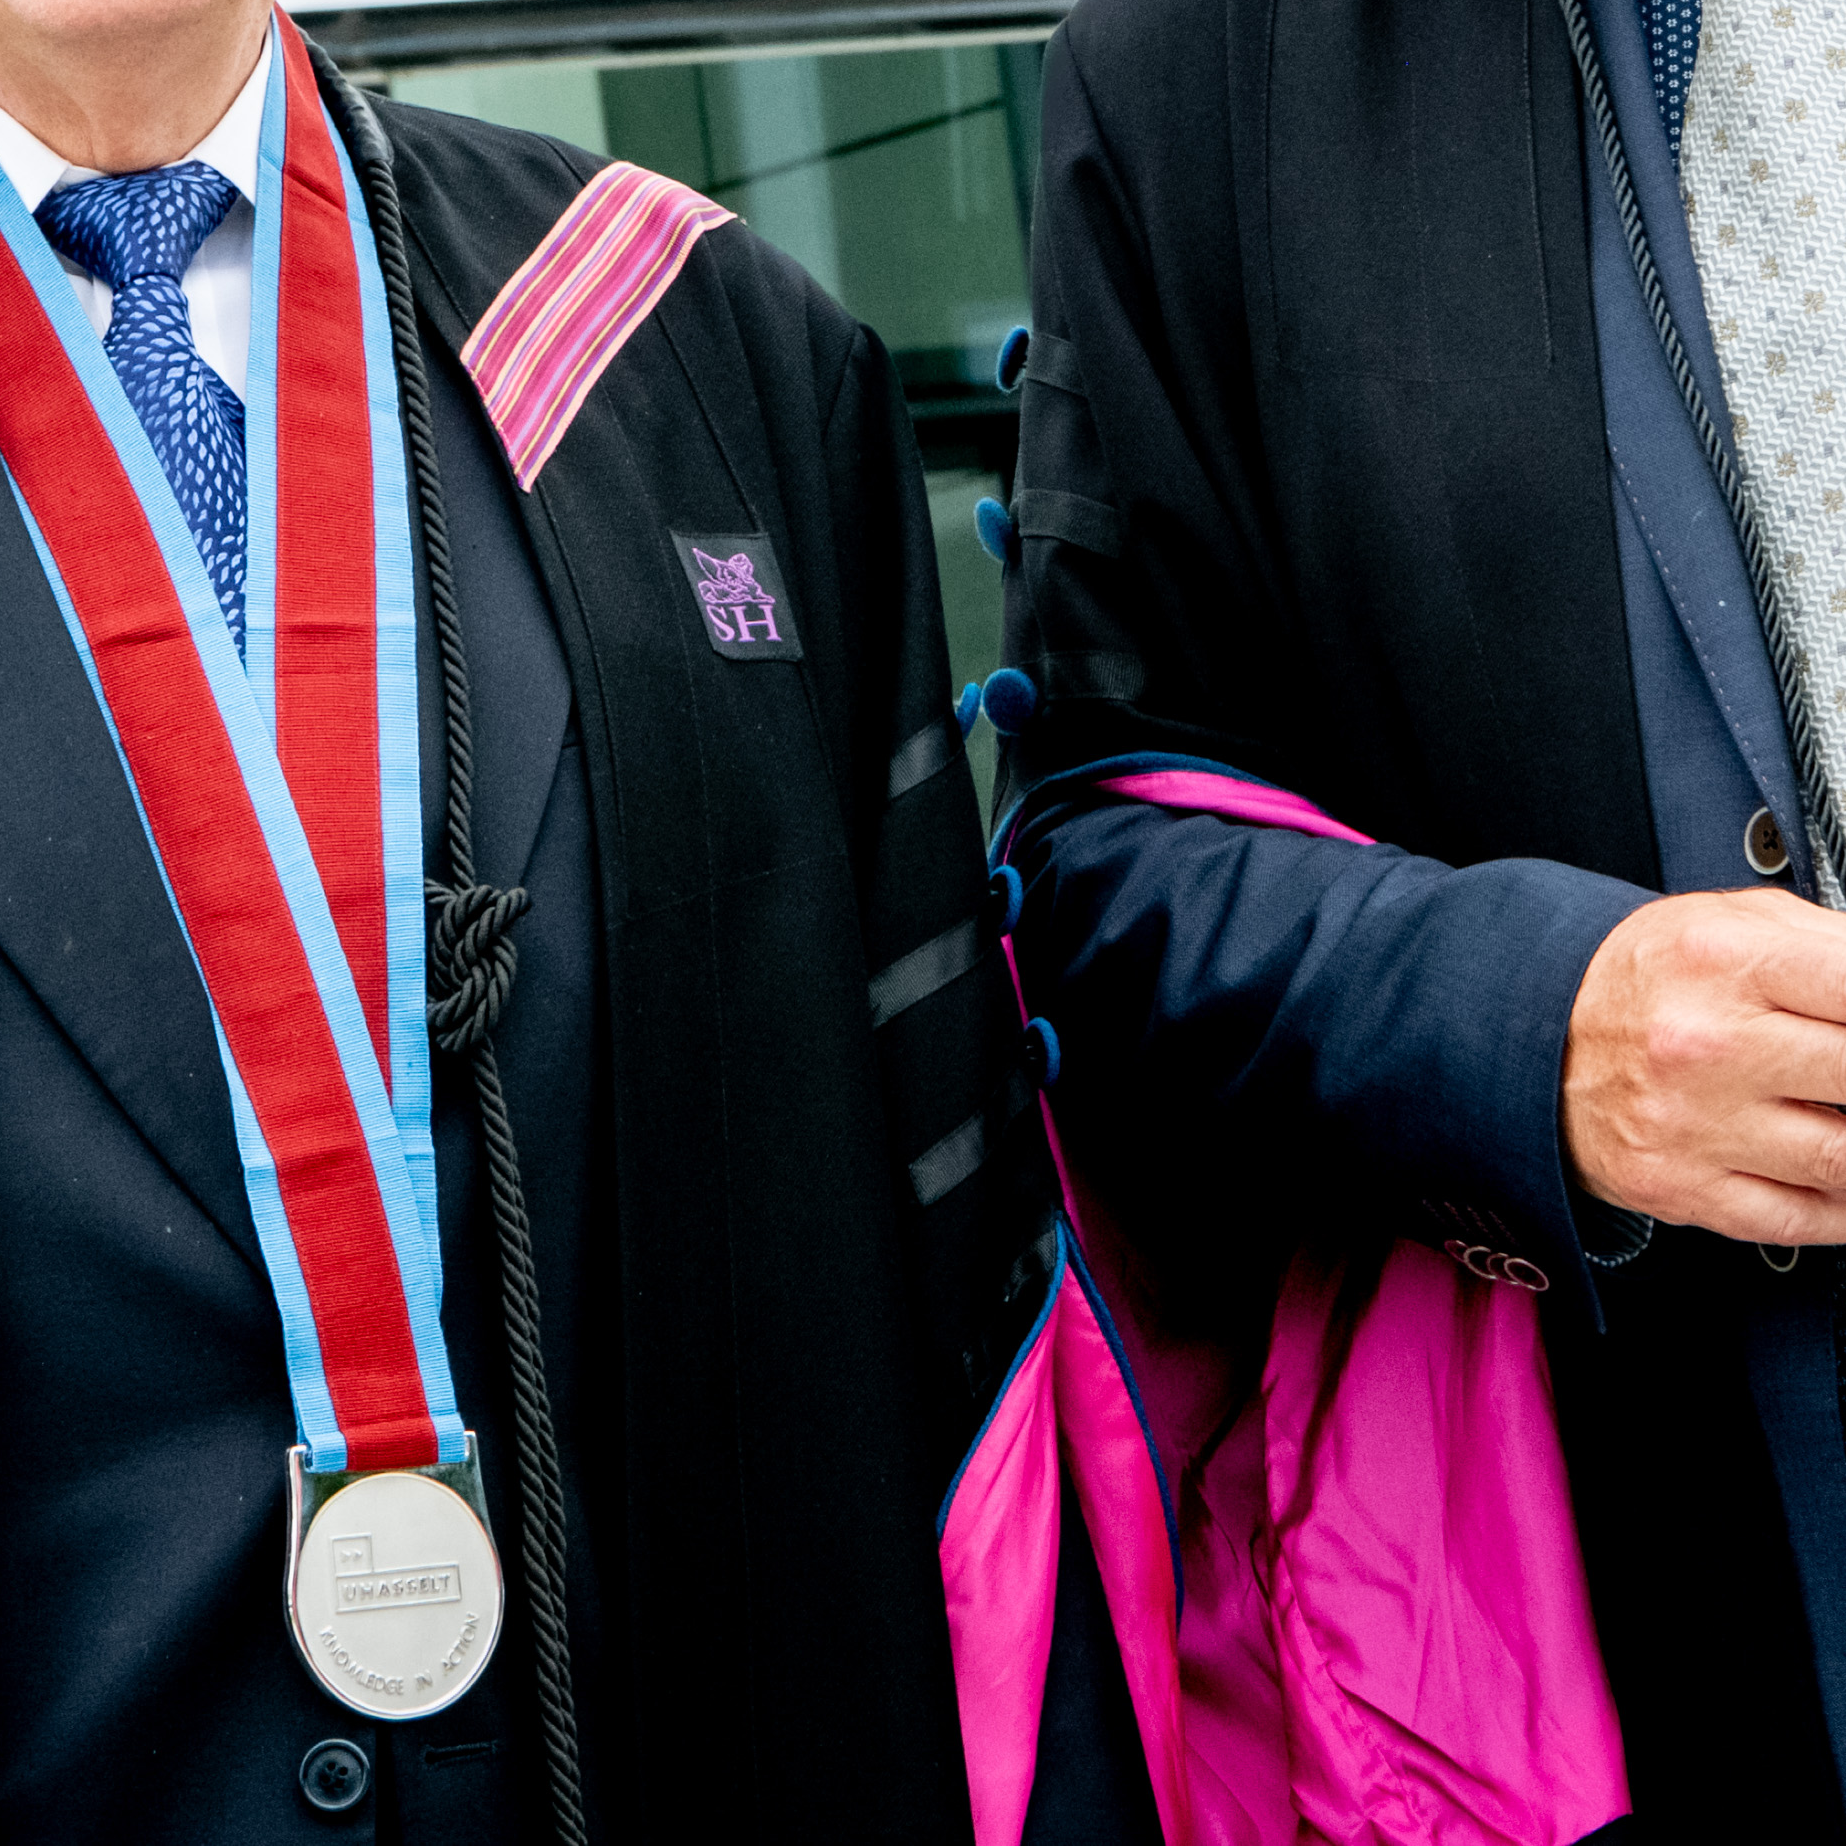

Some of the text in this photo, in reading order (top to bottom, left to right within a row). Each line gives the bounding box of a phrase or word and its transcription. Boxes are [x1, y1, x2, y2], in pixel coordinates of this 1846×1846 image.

[706, 604, 782, 642] SH
[342, 1574, 451, 1601] UHASSELT
[319, 1611, 479, 1695] KNOWLEDGE IN ACTION
